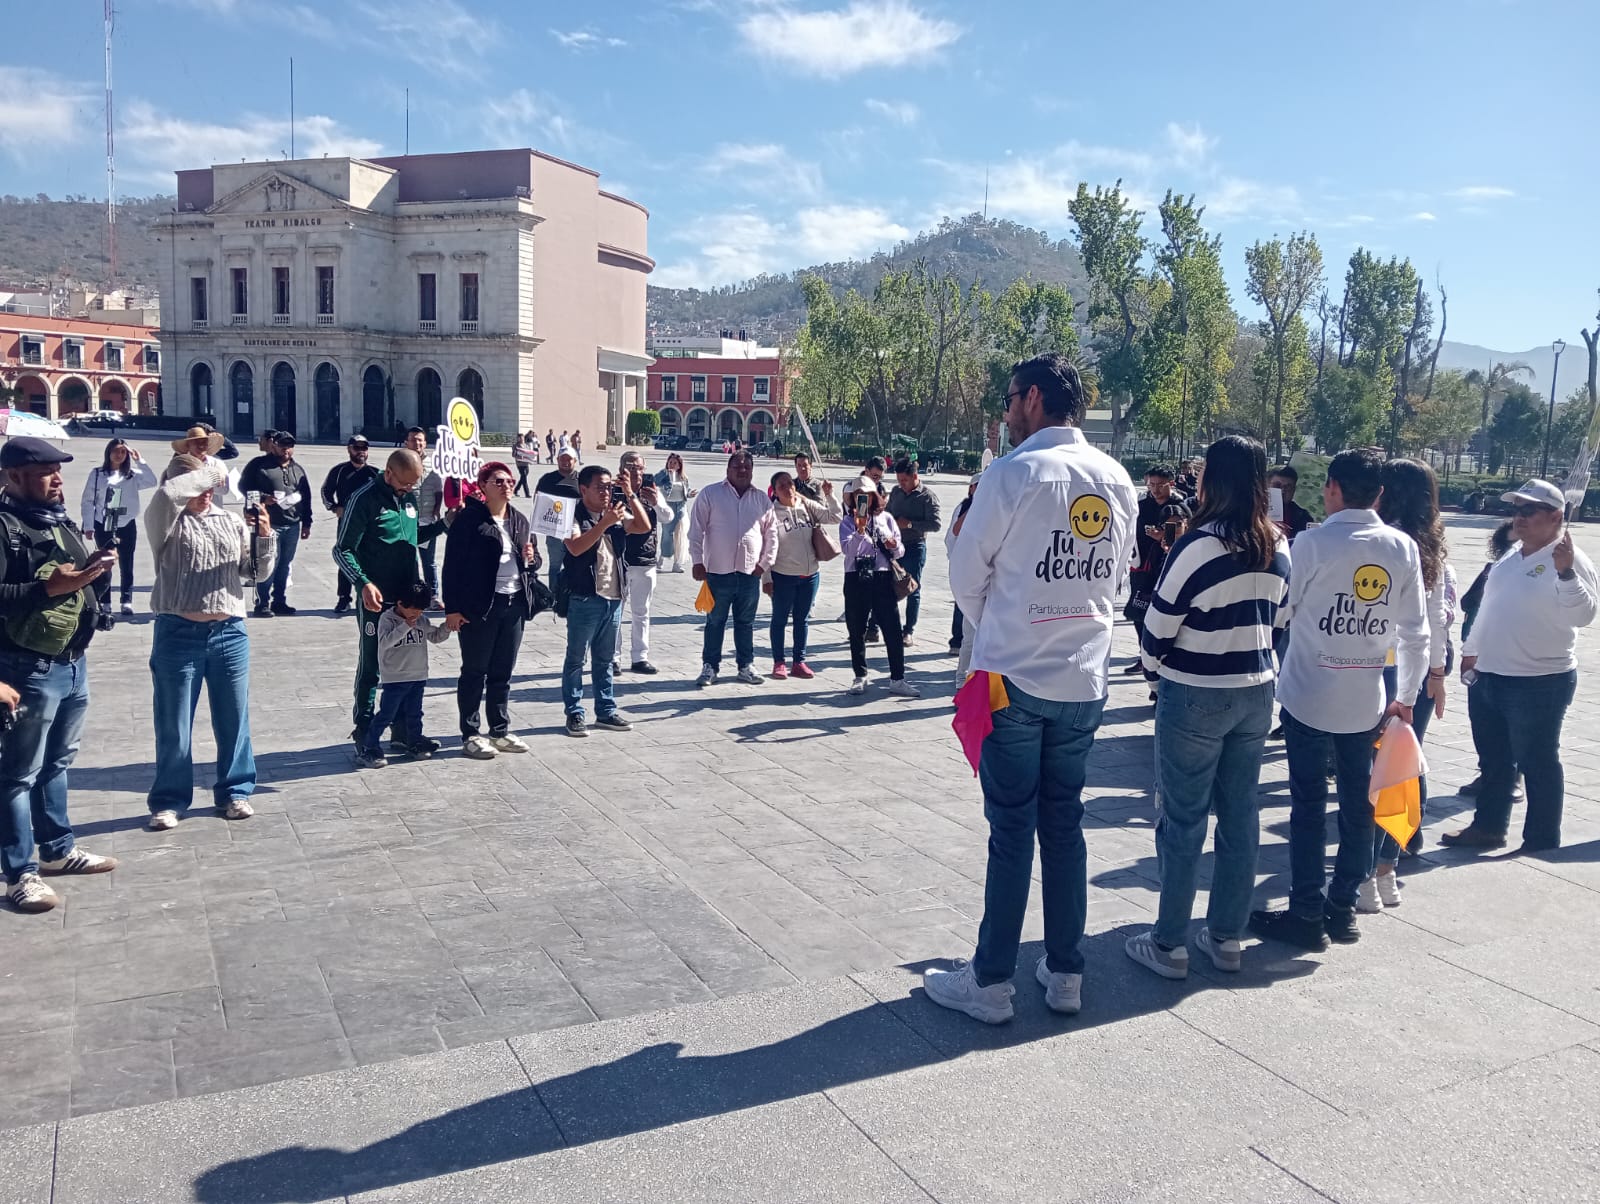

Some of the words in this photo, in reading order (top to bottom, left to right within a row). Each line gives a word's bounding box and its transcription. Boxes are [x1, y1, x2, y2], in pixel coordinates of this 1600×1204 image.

[245, 219, 276, 229] TEATRO
[283, 217, 322, 228] HIDALGO
[440, 428, 455, 453] Tú
[1050, 529, 1074, 557] Tú
[1035, 545, 1114, 583] decides
[1070, 605, 1087, 615] con
[1334, 592, 1355, 615] Tú
[1318, 606, 1389, 637] decides
